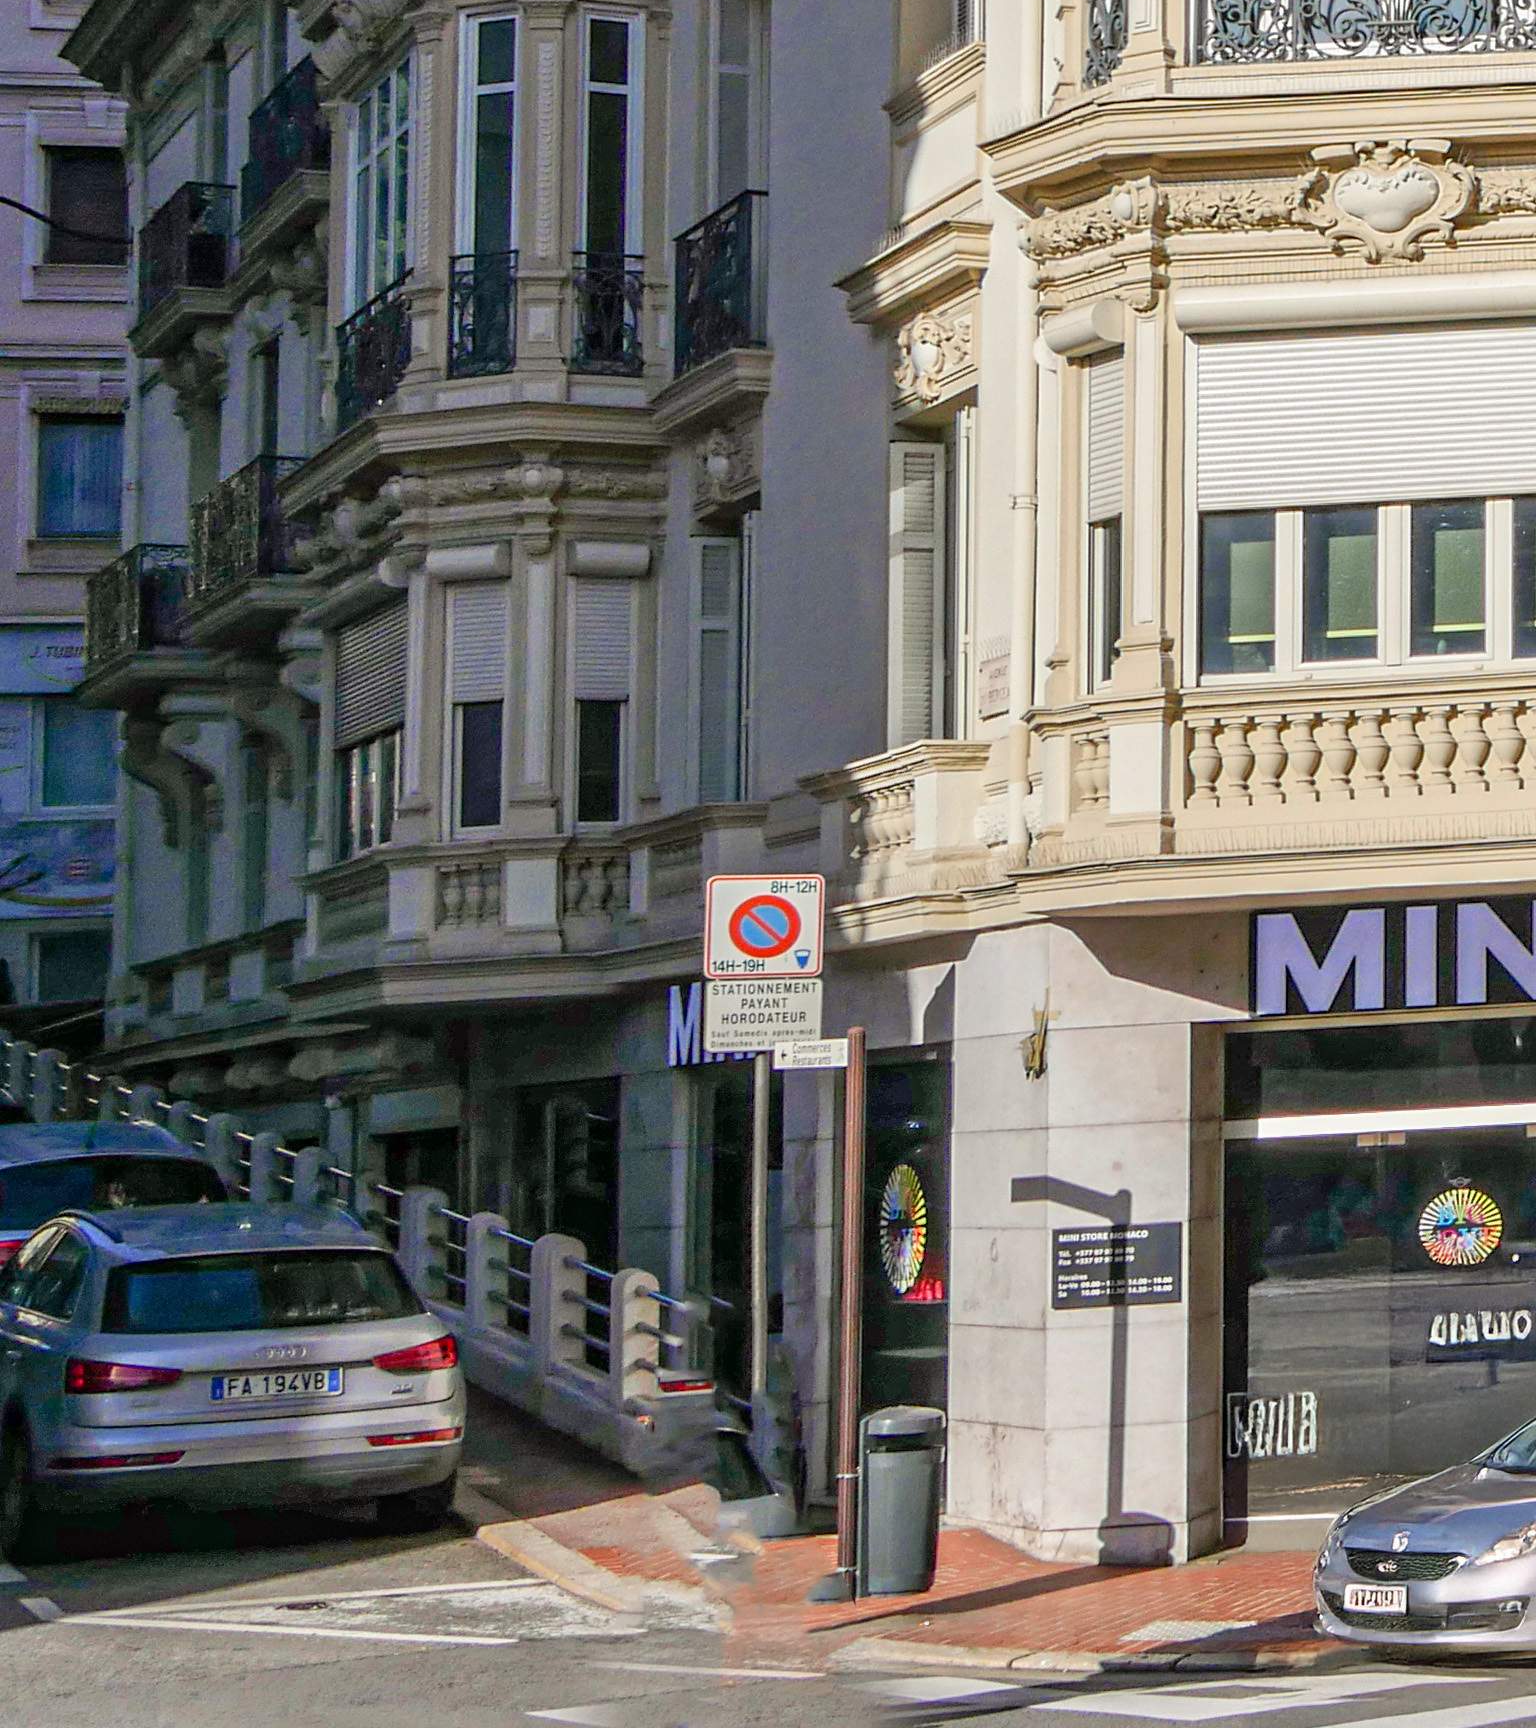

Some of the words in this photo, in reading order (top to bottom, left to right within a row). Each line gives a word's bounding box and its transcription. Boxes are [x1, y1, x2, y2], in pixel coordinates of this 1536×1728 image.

[770, 880, 818, 894] 8H-12H
[711, 959, 765, 973] 14H-19H
[712, 982, 818, 996] STATIONNEMENT
[740, 997, 789, 1009] PAYANT
[720, 1011, 807, 1025] HORODATEUR
[227, 1378, 252, 1397] FA
[263, 1371, 326, 1394] 194VB
